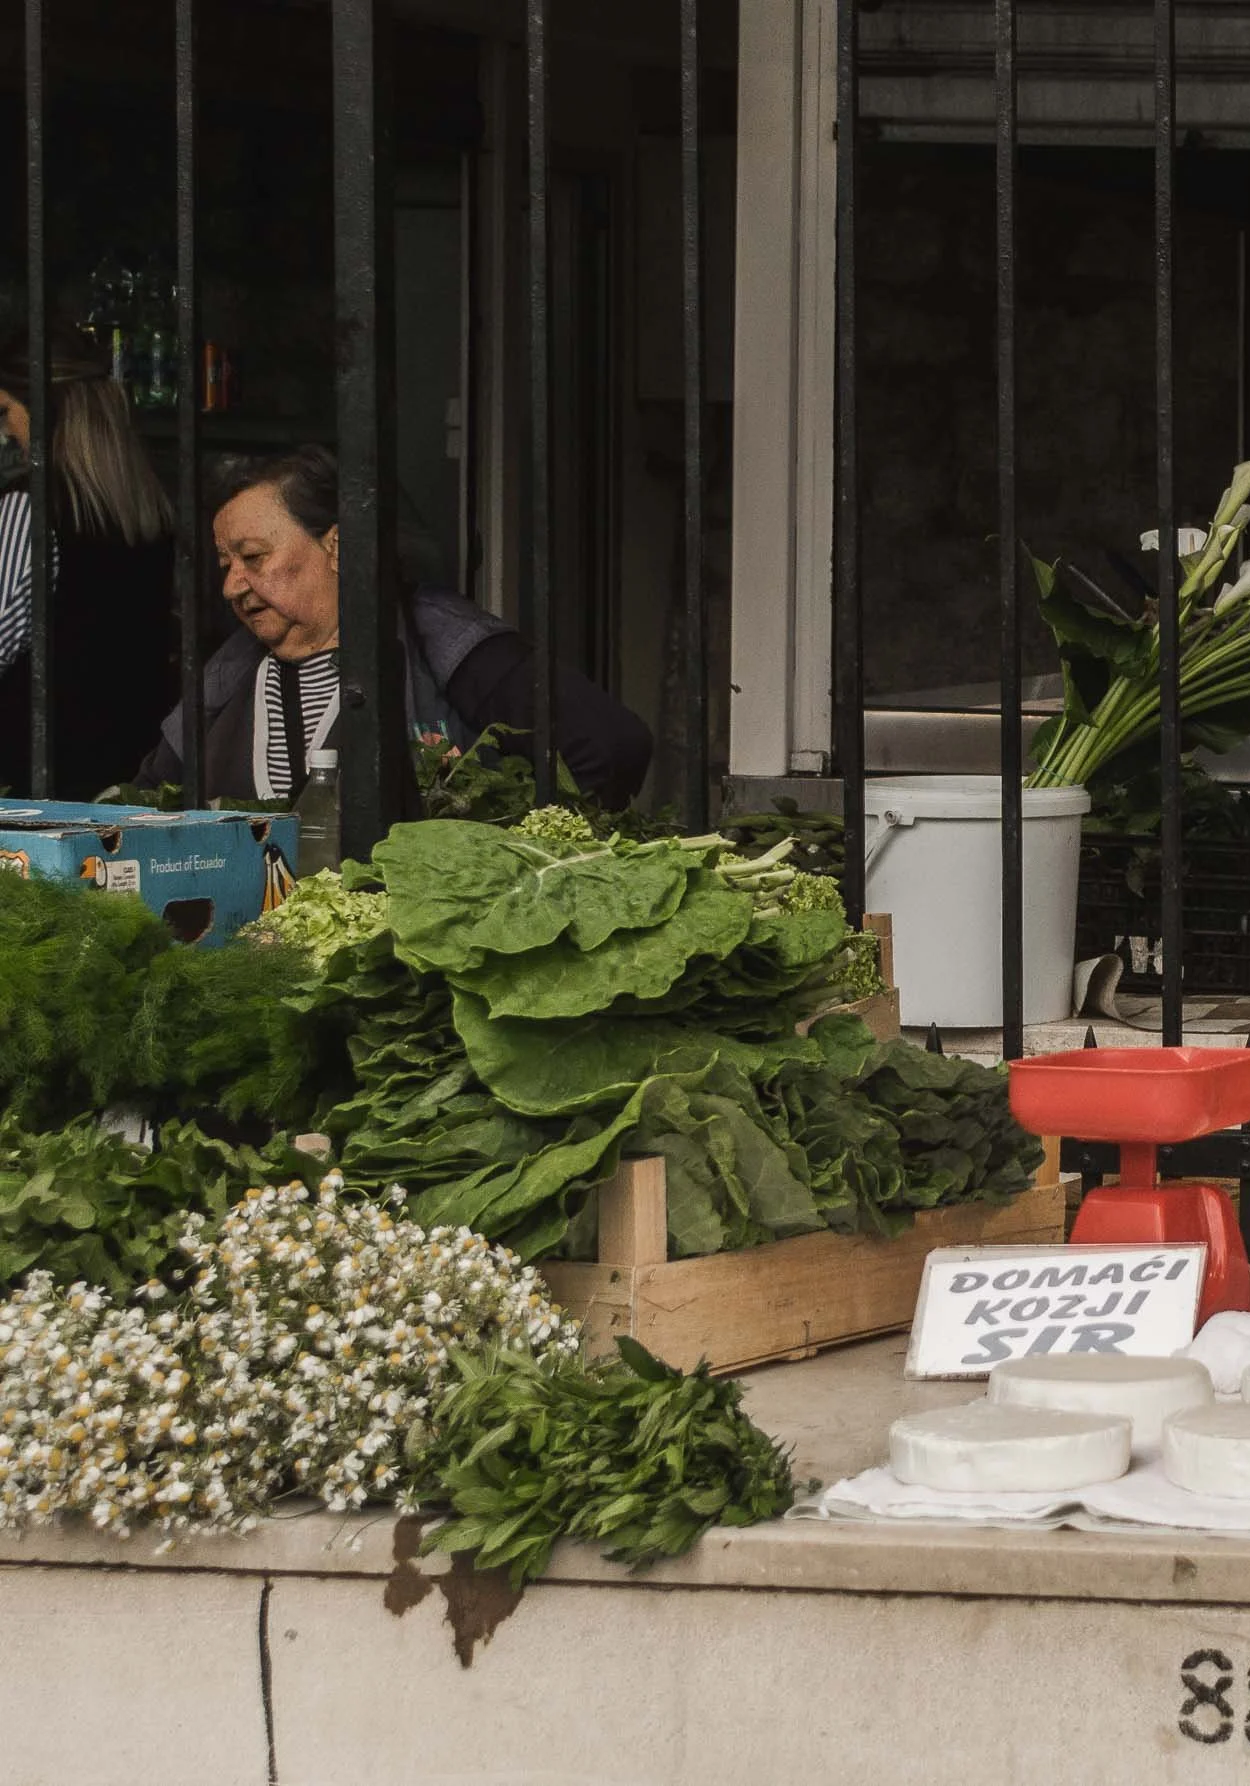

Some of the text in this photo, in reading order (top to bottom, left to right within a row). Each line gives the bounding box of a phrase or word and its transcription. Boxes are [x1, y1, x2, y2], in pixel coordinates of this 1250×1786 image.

[150, 858, 182, 874] Product
[184, 855, 194, 871] of
[194, 853, 226, 870] Ecuador
[948, 1254, 1190, 1294] DOMAĆI
[964, 1289, 1151, 1326] KOZJI
[961, 1321, 1136, 1365] SIR
